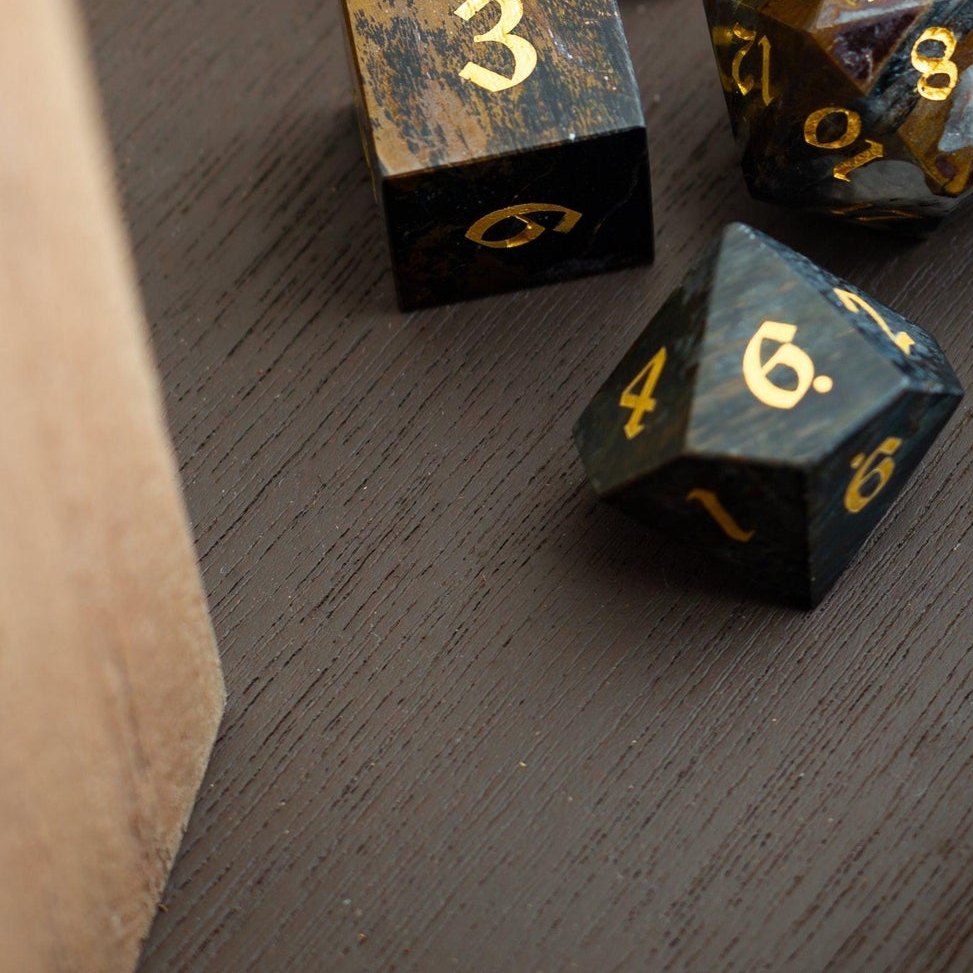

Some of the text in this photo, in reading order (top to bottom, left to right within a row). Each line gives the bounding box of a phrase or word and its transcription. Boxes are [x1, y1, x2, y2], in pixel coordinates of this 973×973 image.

[910, 27, 959, 101] 8
[803, 106, 885, 183] 10
[619, 346, 668, 441] 4
